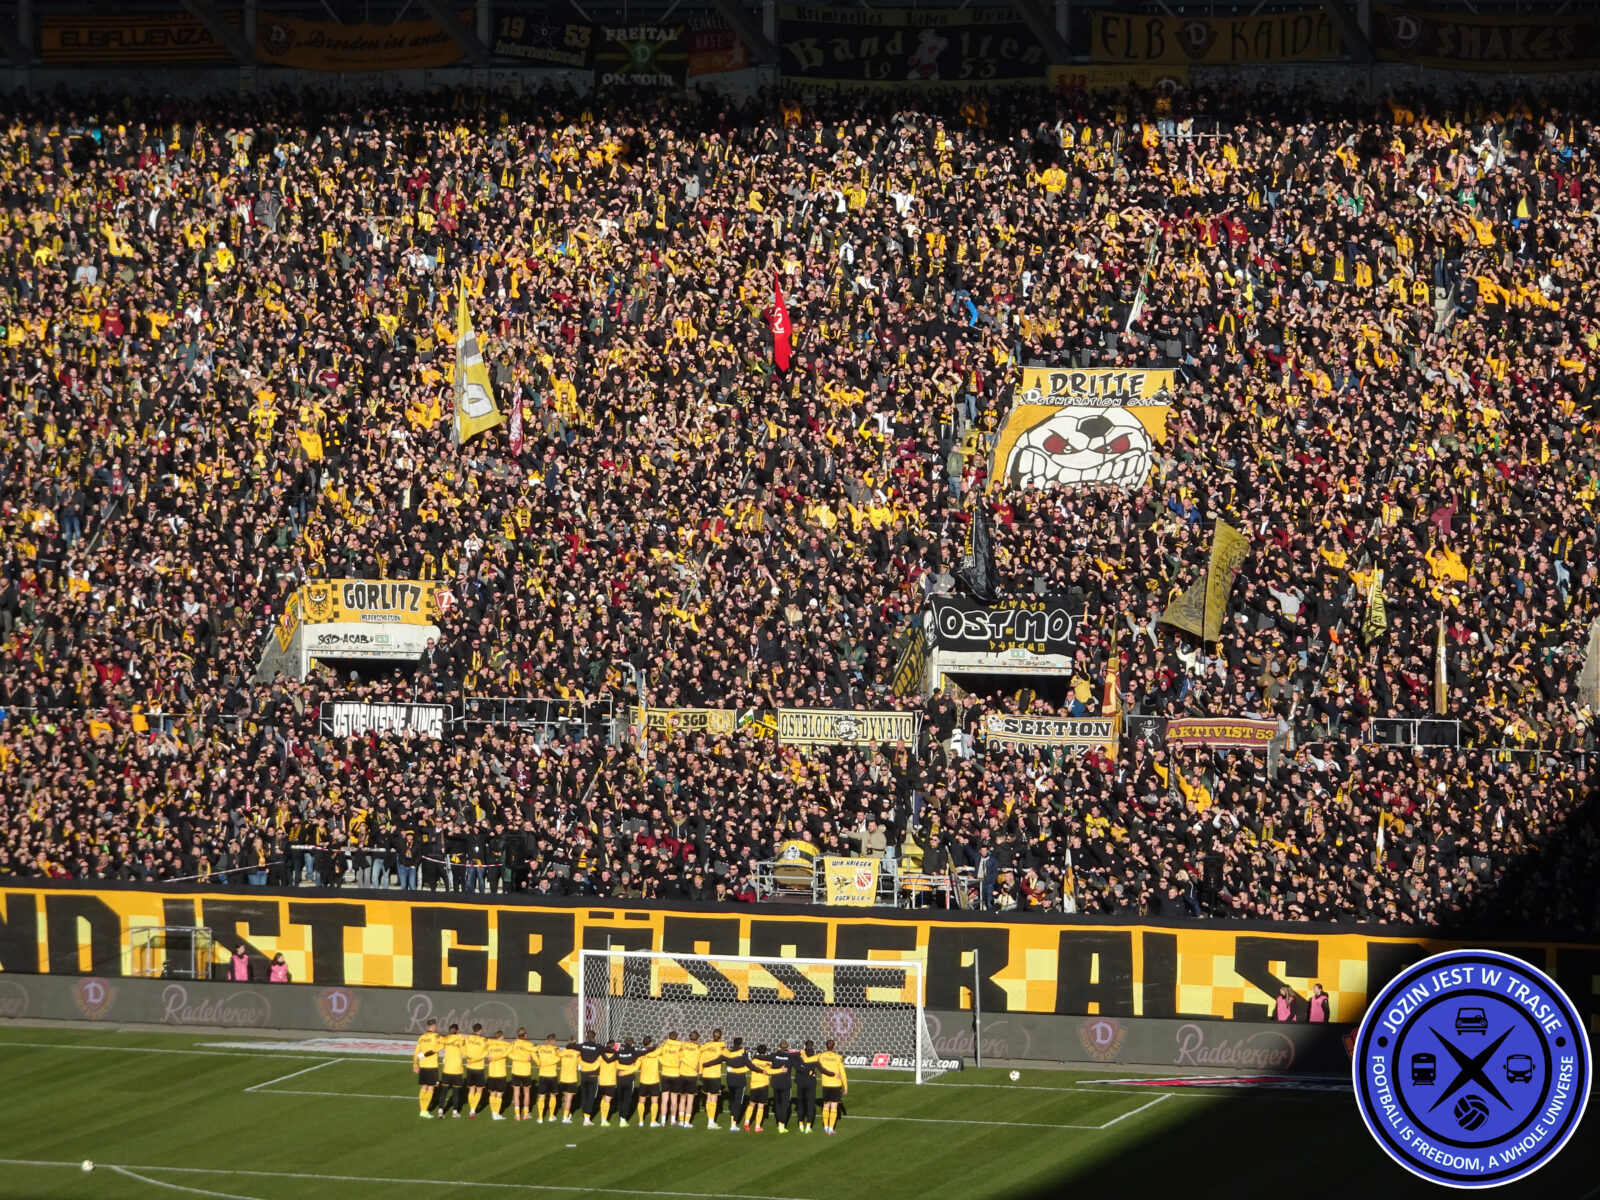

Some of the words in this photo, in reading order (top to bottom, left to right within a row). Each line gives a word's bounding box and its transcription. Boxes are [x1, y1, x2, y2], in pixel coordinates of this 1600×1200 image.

[502, 16, 525, 39] 19
[563, 24, 592, 48] 53
[606, 27, 678, 41] FREITAL
[1100, 16, 1166, 60] ELB
[1231, 12, 1332, 60] KAIDA
[1437, 24, 1576, 61] SNAKES
[602, 73, 627, 85] ON
[634, 74, 674, 87] TOUR
[959, 58, 997, 79] 53
[1049, 371, 1146, 397] DRITTE
[1038, 396, 1122, 406] GENERATION
[343, 579, 422, 613] GÖRLITZ
[333, 703, 406, 739] OSTDEUTSCHE
[410, 706, 443, 740] JUNGS
[683, 713, 708, 726] SGD
[780, 714, 837, 738] OSTBLOCK
[862, 717, 912, 741] DYNAMO
[1003, 718, 1112, 738] SEKTION
[1168, 725, 1253, 740] AKTIVIST
[1255, 727, 1275, 741] 53
[163, 896, 367, 986] IST
[1057, 929, 1320, 1023] ALS
[1174, 1024, 1289, 1068] Radeberger
